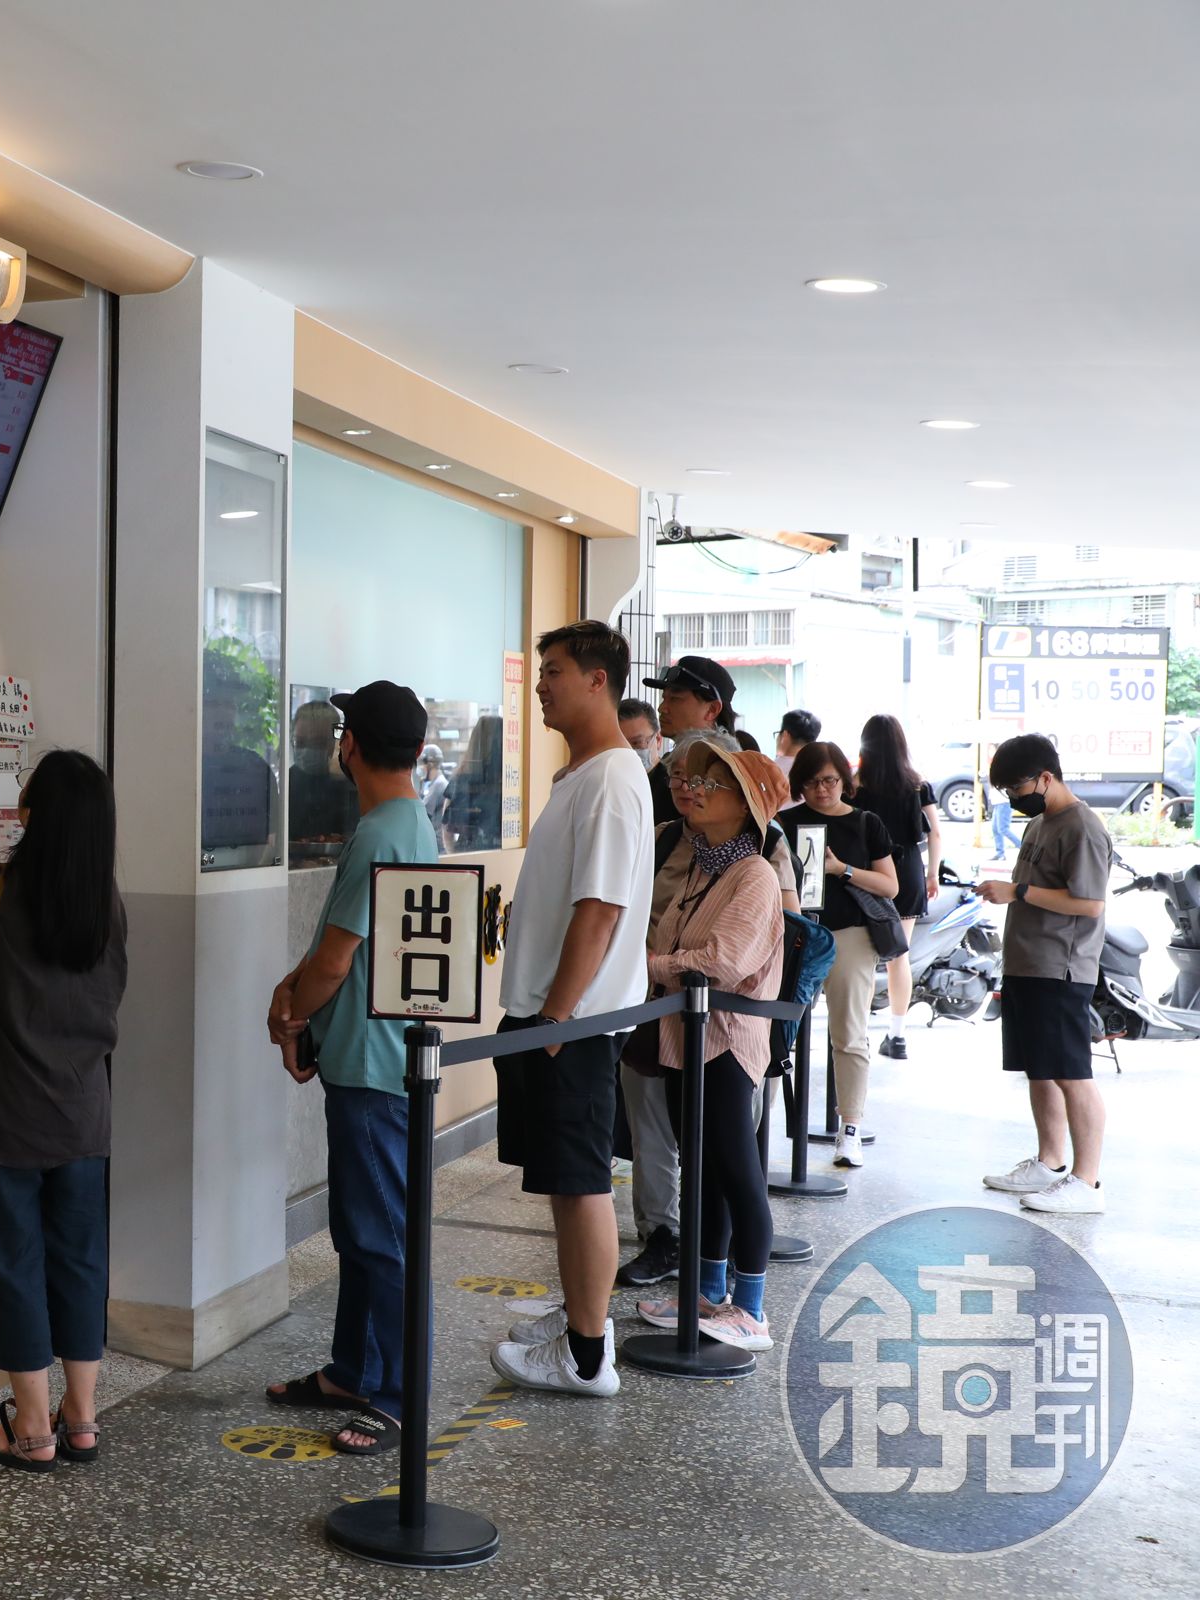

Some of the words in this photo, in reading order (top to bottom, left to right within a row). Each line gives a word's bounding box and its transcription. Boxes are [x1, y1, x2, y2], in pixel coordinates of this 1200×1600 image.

[1031, 680, 1059, 700] 10
[1110, 681, 1155, 701] 500
[401, 884, 452, 1003] 出口
